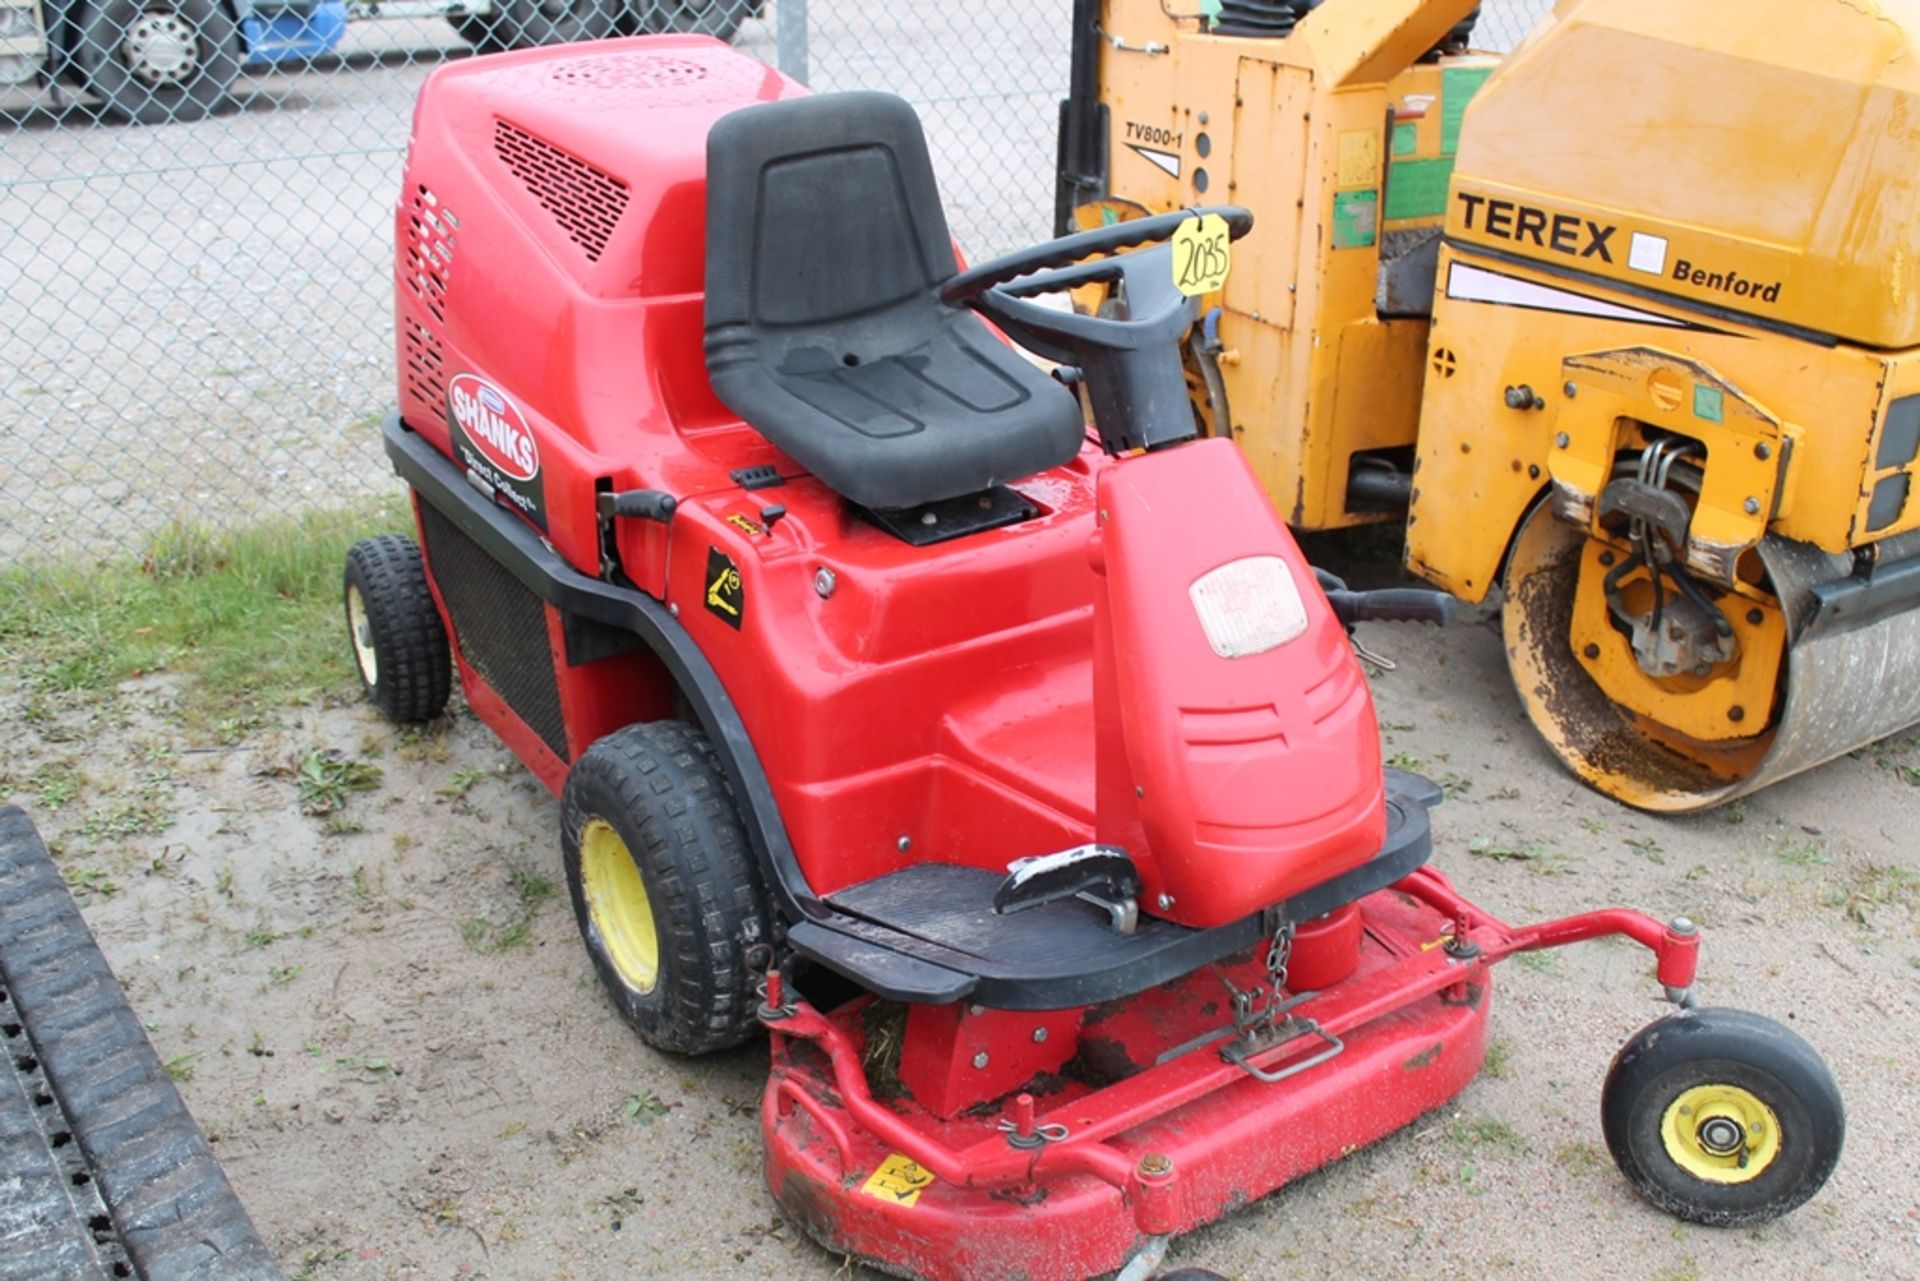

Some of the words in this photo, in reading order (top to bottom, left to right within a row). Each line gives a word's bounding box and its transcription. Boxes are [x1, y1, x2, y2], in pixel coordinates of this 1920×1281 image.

[1126, 121, 1182, 149] TV800-1
[1458, 192, 1617, 263] TEREX
[1179, 233, 1227, 286] 2035
[1672, 259, 1782, 303] Benford
[453, 384, 534, 475] SHANKS
